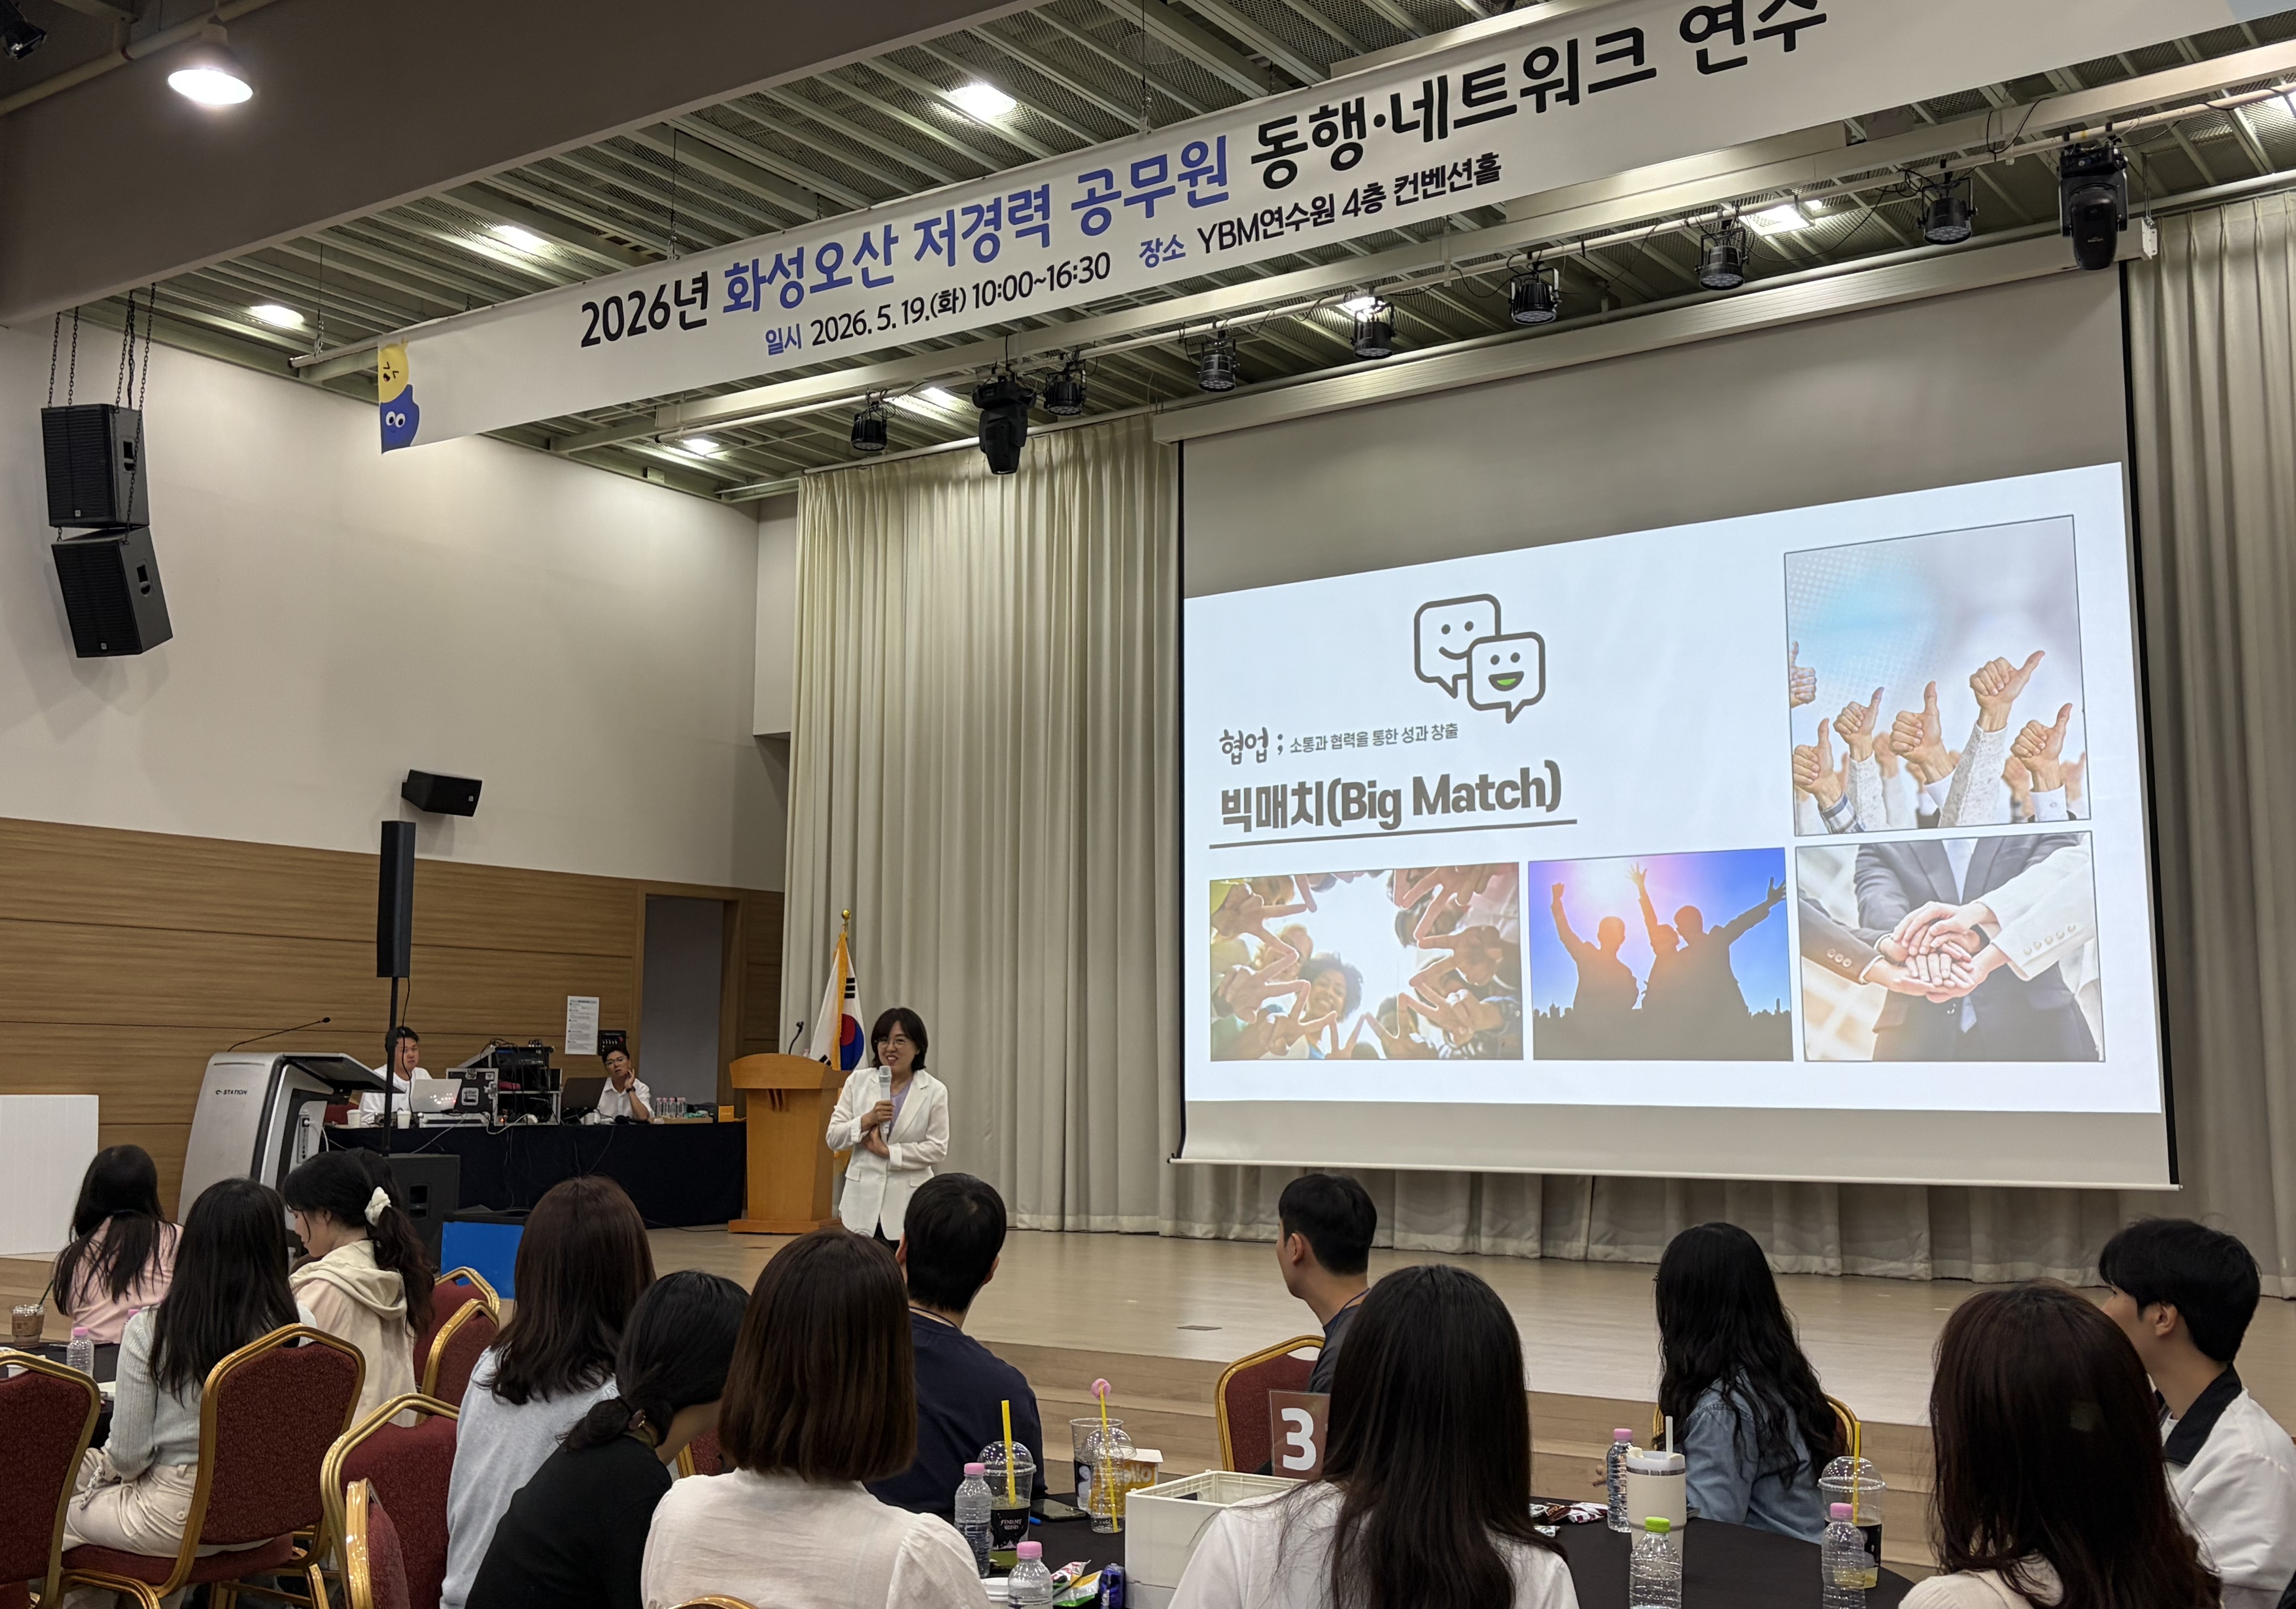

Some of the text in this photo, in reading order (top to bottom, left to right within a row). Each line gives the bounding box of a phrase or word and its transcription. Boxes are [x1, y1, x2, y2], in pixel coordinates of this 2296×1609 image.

[581, 271, 709, 348] 2026년
[723, 224, 899, 313] 화성오산
[914, 184, 1050, 267] 저경력
[1071, 135, 1229, 236] 공무원
[1679, 0, 1827, 75] 연수
[765, 323, 802, 356] 일시
[972, 252, 1111, 309] 10:00~16:30
[1139, 234, 1186, 268] 장소
[1197, 193, 1335, 254] YBM연수원
[1342, 182, 1386, 217] 4층
[1393, 151, 1502, 207] 컨벤션홀
[1219, 727, 1269, 765] 협업
[1290, 735, 1328, 753] 소통과
[1330, 731, 1368, 749] 협력을
[1373, 729, 1398, 746] 통한
[1401, 725, 1428, 743] 성과
[1431, 723, 1458, 741] 창출
[1222, 759, 1561, 833] 빅매치(Big Match)
[1281, 1407, 1316, 1471] 3
